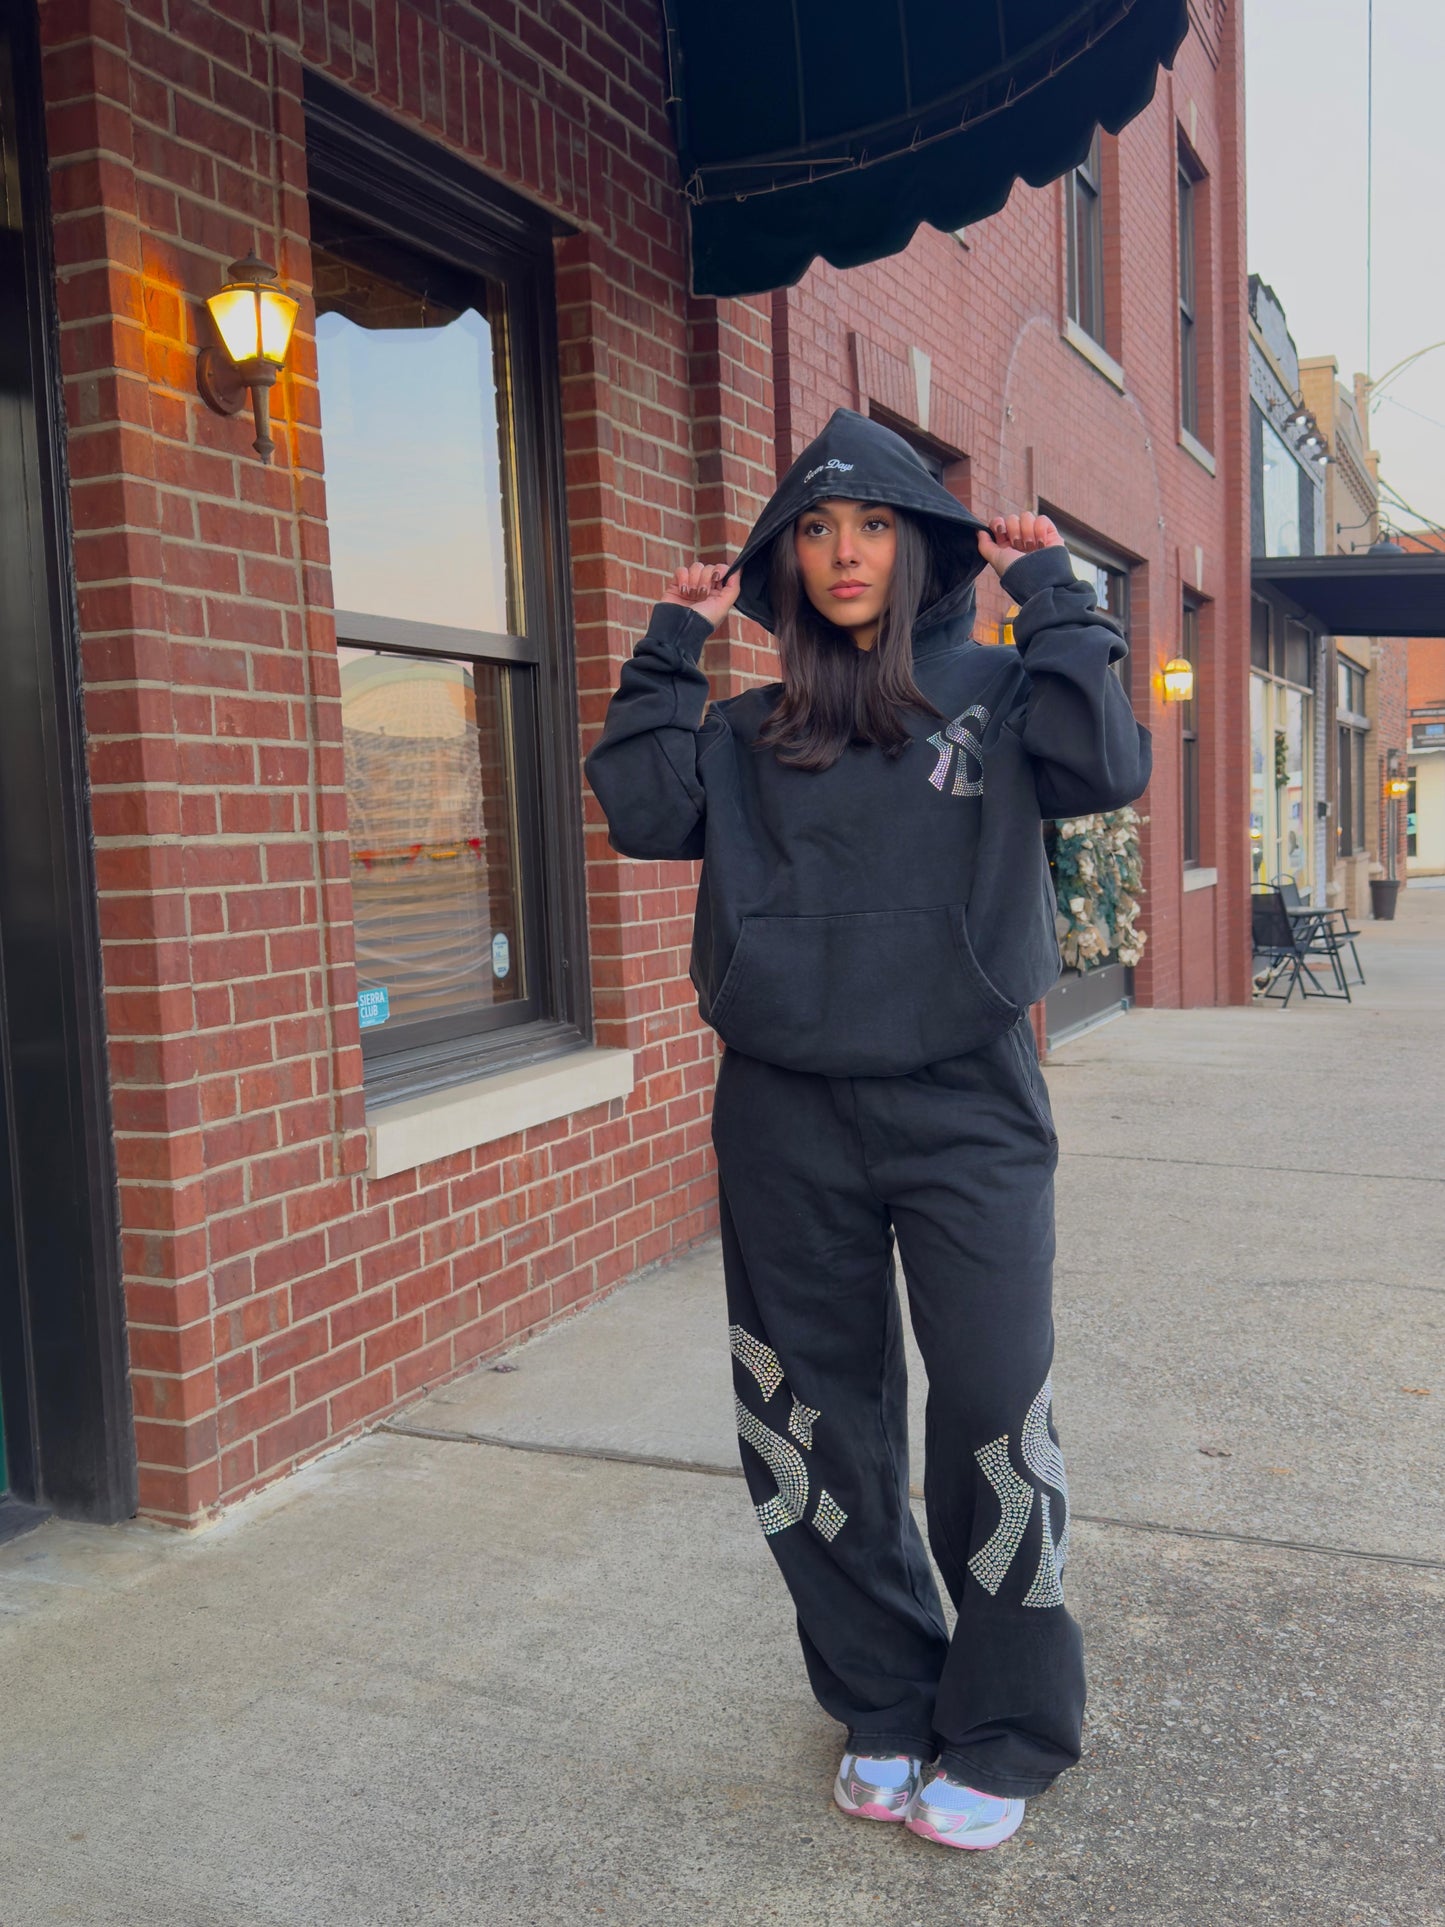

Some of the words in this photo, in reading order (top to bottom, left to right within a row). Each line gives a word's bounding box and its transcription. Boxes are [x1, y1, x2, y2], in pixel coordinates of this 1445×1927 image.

[825, 459, 854, 472] Days
[360, 992, 384, 1006] SIERRA
[361, 1005, 378, 1018] CLUB
